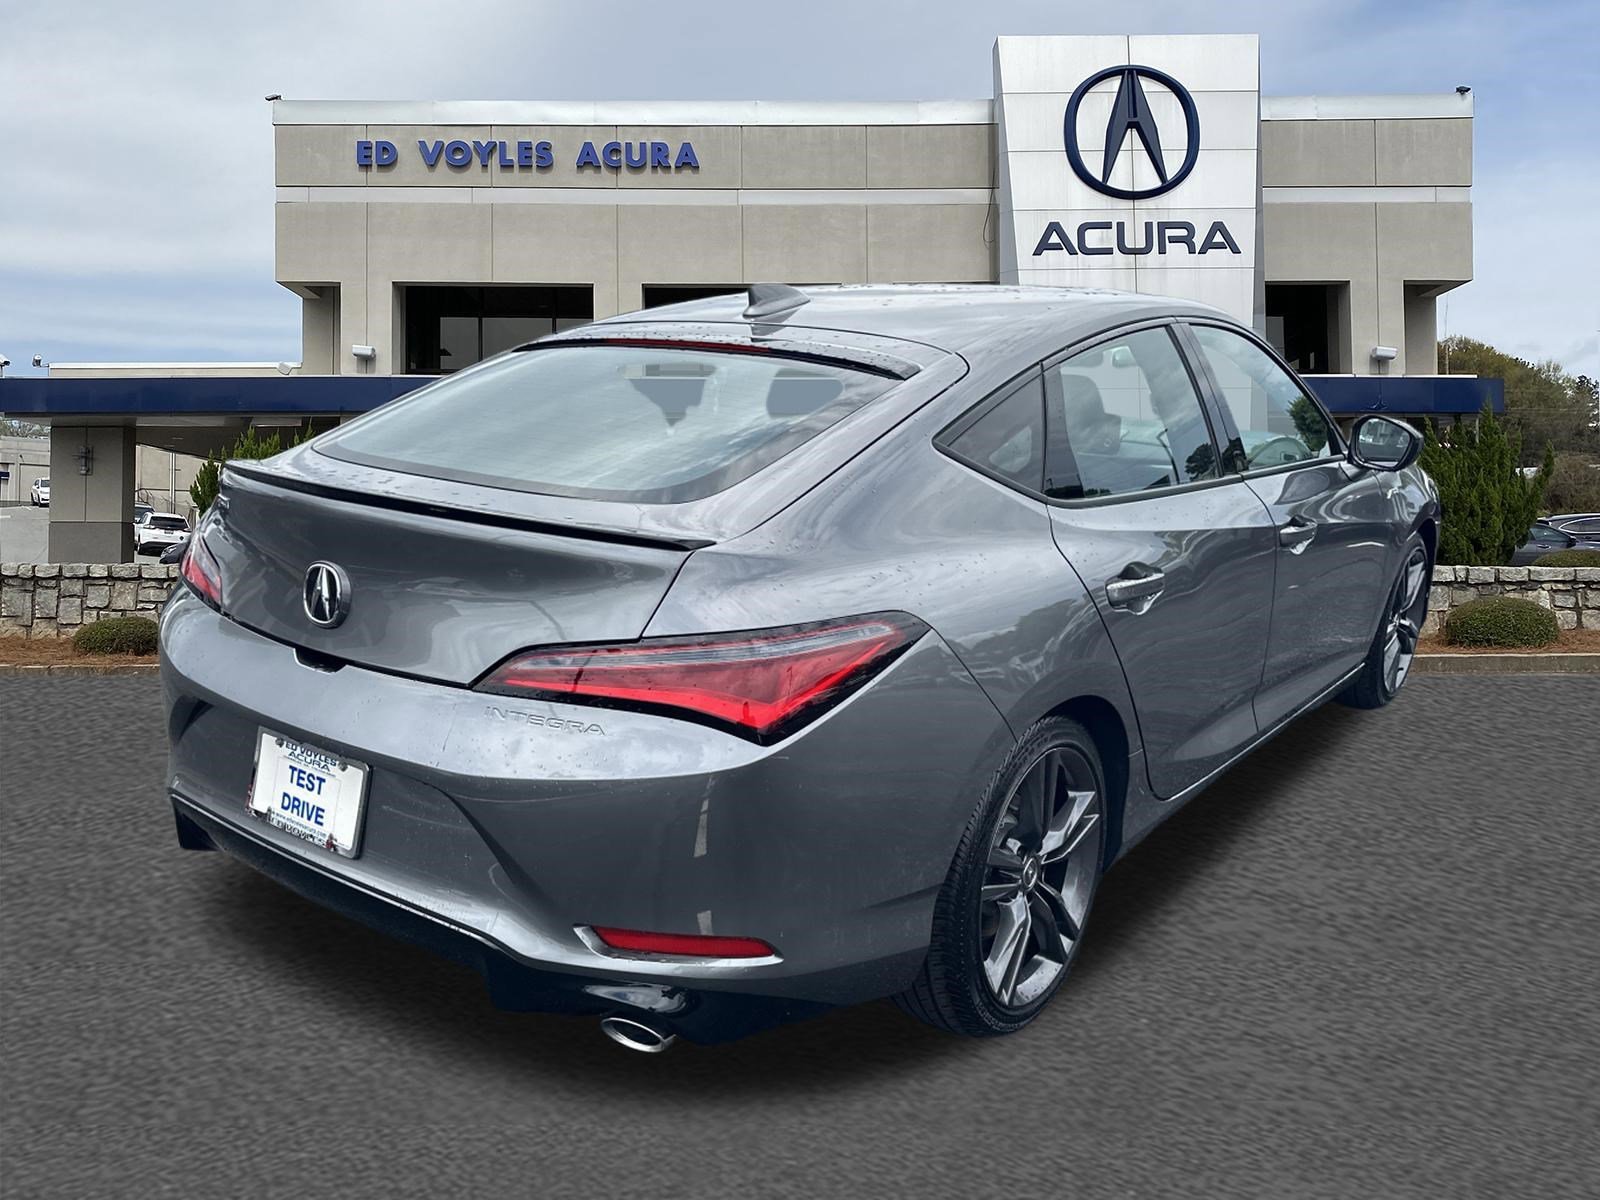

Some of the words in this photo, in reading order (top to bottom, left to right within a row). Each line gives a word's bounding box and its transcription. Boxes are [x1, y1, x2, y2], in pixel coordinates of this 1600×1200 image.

[356, 140, 398, 166] ED
[418, 140, 554, 167] VOYLES
[576, 141, 700, 168] ACURA
[1032, 221, 1242, 256] ACURA
[484, 705, 606, 736] INTEGRA
[286, 742, 298, 751] ED
[300, 745, 336, 767] VOYLES
[288, 751, 331, 772] ACURA
[289, 765, 326, 795] TEST
[281, 791, 325, 826] DRIVE
